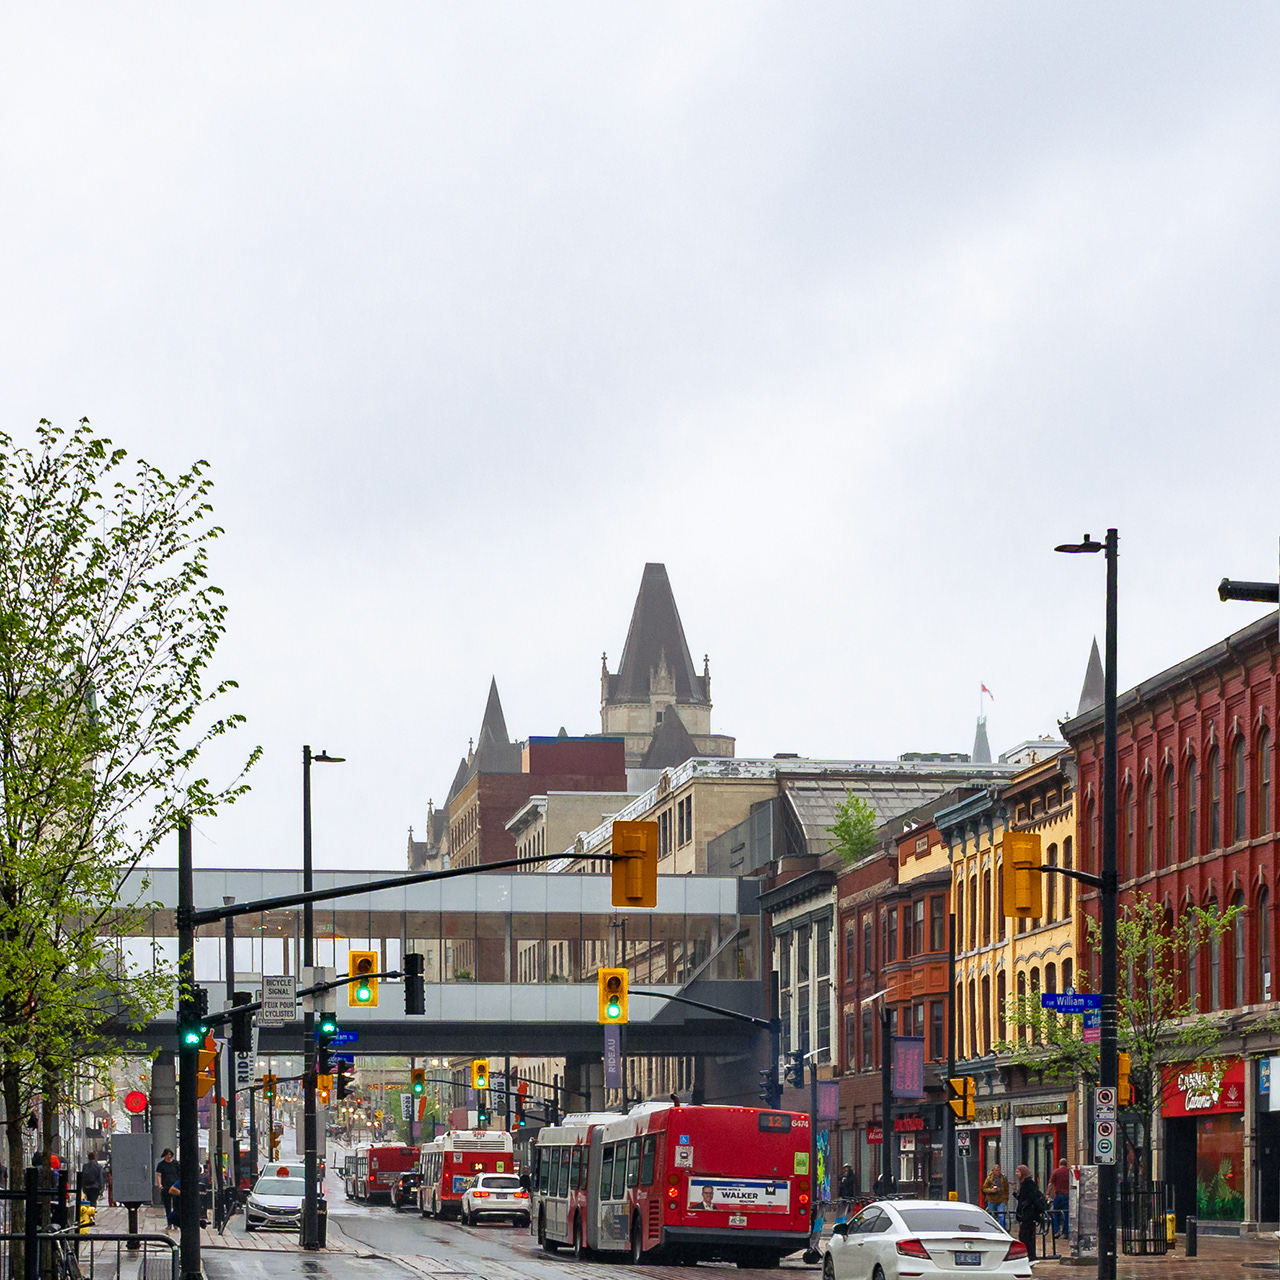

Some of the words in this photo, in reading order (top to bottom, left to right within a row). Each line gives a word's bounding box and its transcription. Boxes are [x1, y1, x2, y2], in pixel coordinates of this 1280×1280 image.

[266, 979, 292, 987] BICYCLE
[264, 1001, 279, 1009] FEUX
[280, 1001, 294, 1009] POUR
[1056, 996, 1085, 1006] William
[265, 1009, 294, 1017] CYCLISTES
[608, 1039, 616, 1073] RIDEAU
[768, 1116, 782, 1127] 12
[791, 1120, 809, 1128] 6474
[721, 1191, 759, 1200] WALKER
